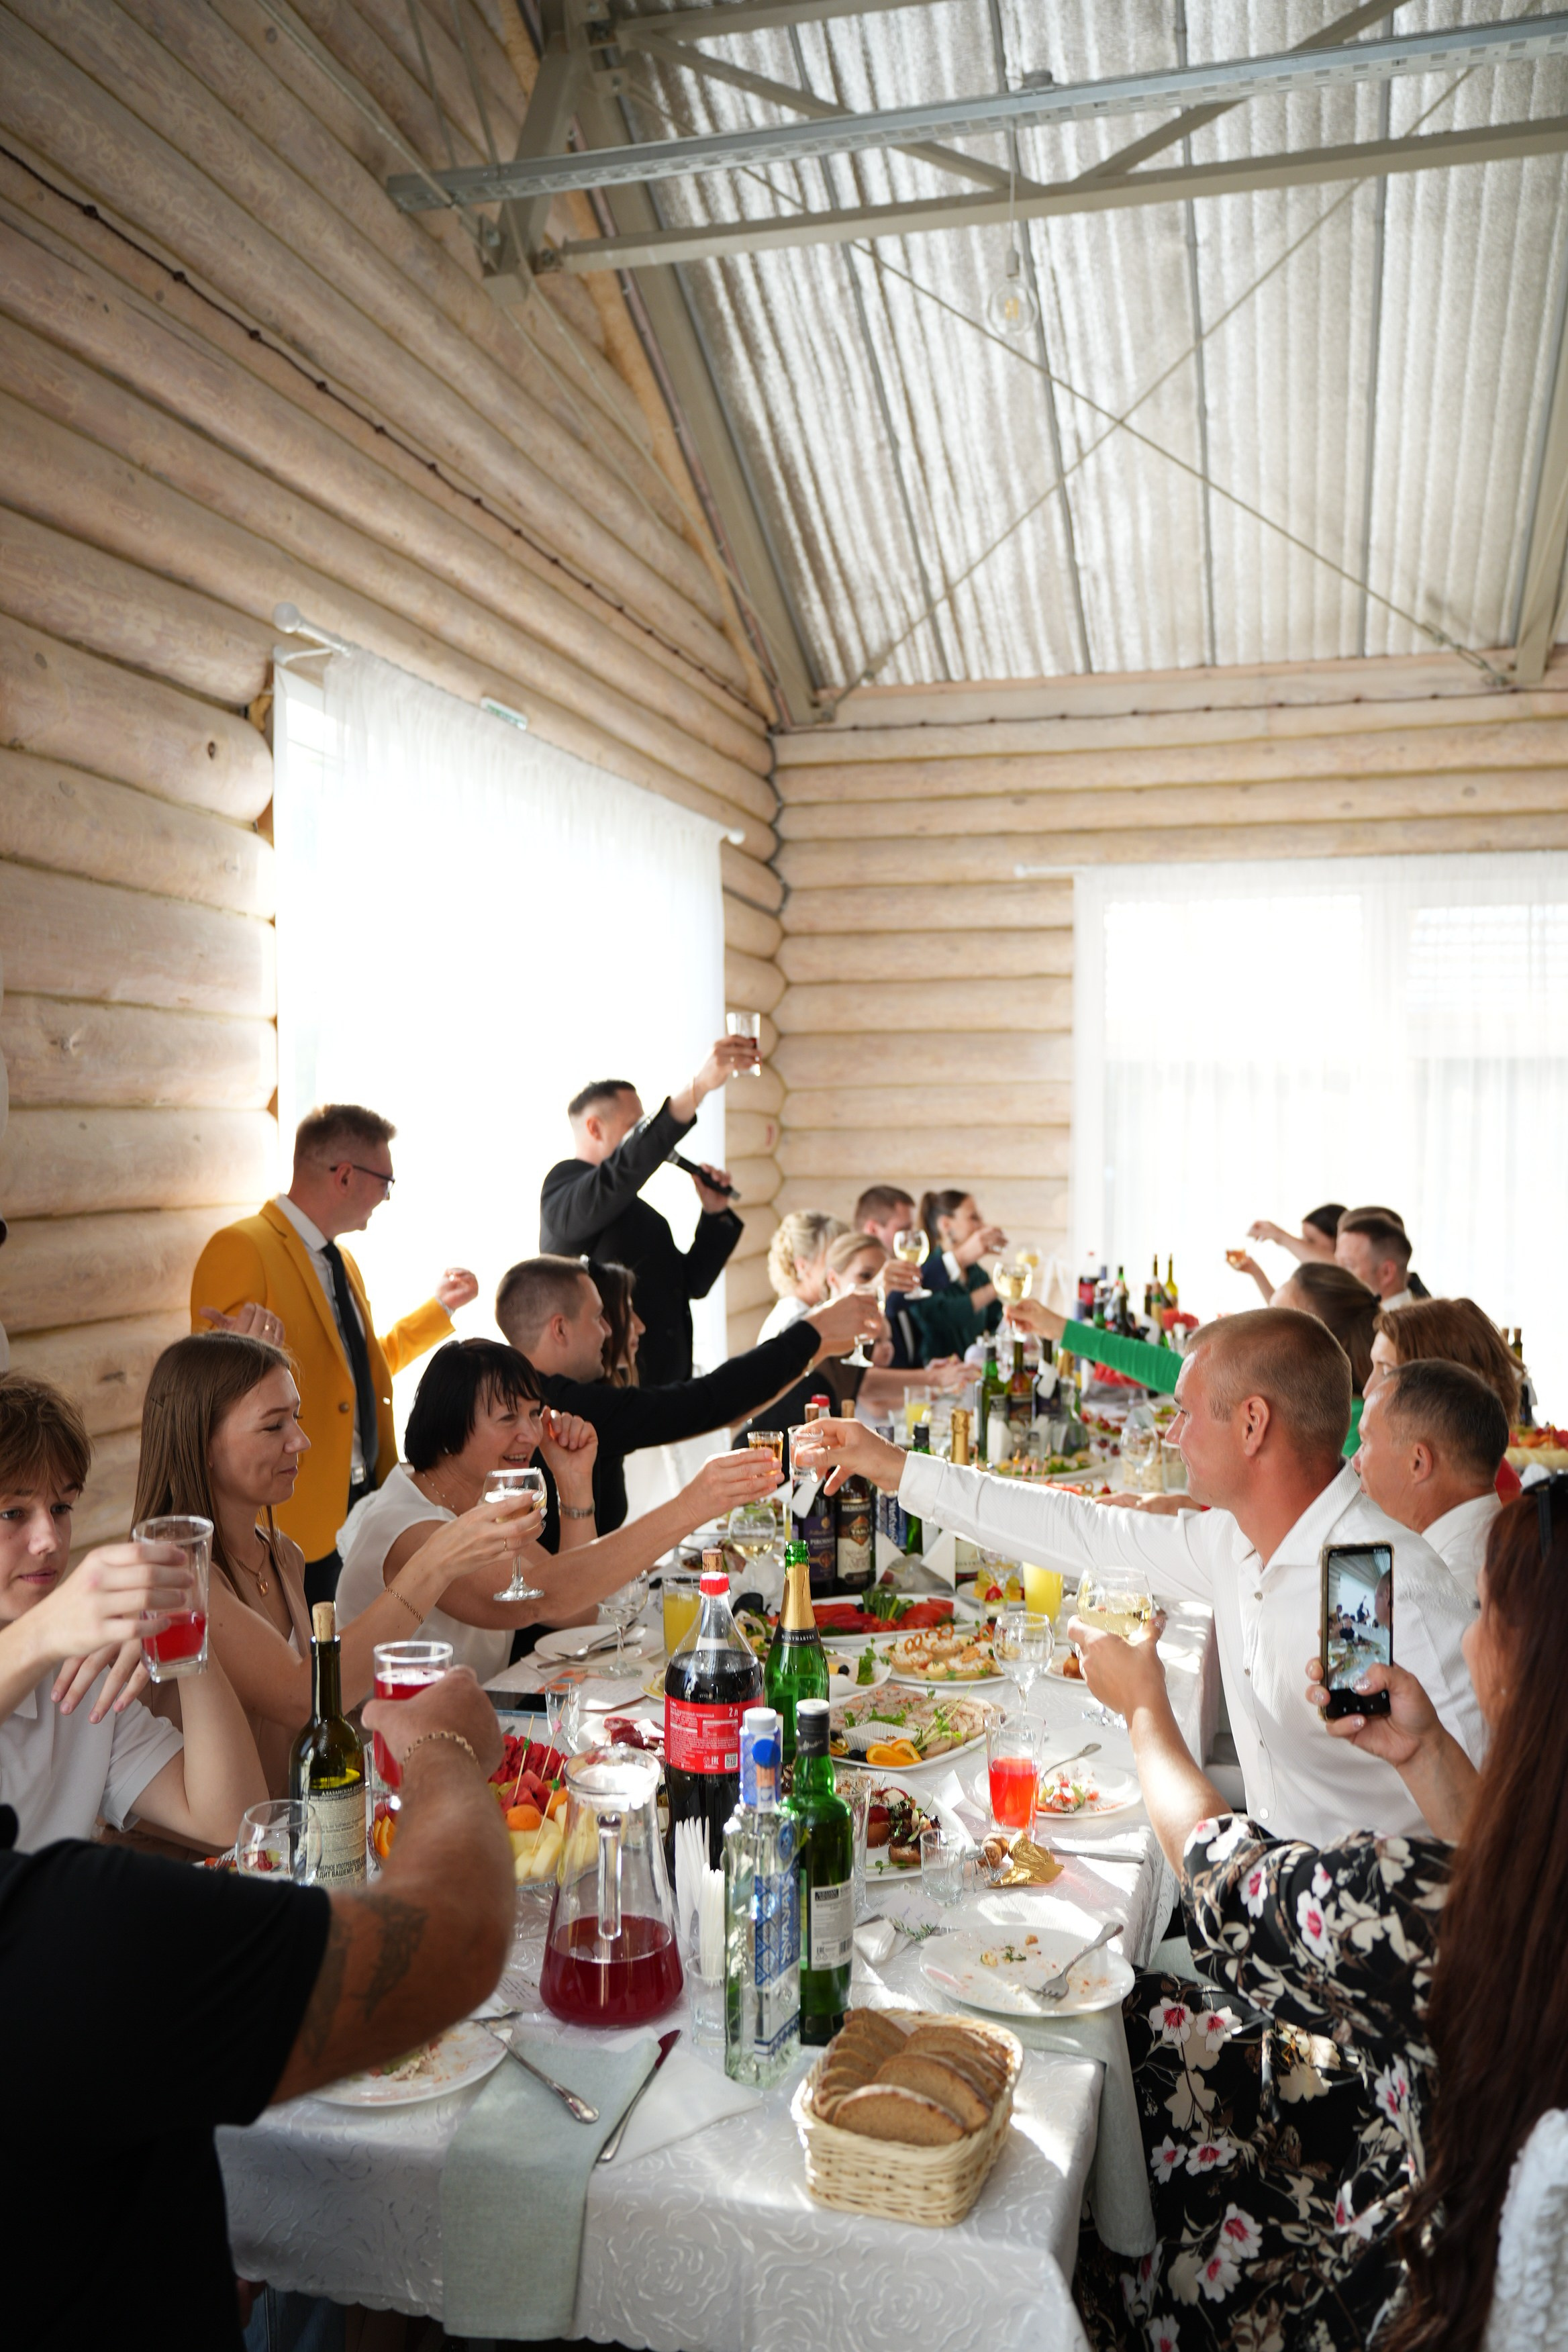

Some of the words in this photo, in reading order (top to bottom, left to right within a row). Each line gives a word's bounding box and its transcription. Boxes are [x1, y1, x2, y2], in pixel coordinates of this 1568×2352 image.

[729, 1706, 733, 1717] 2
[322, 1787, 353, 1796] АЛАЗАНСКАЯ
[332, 1866, 353, 1878] ВАШЕМУ
